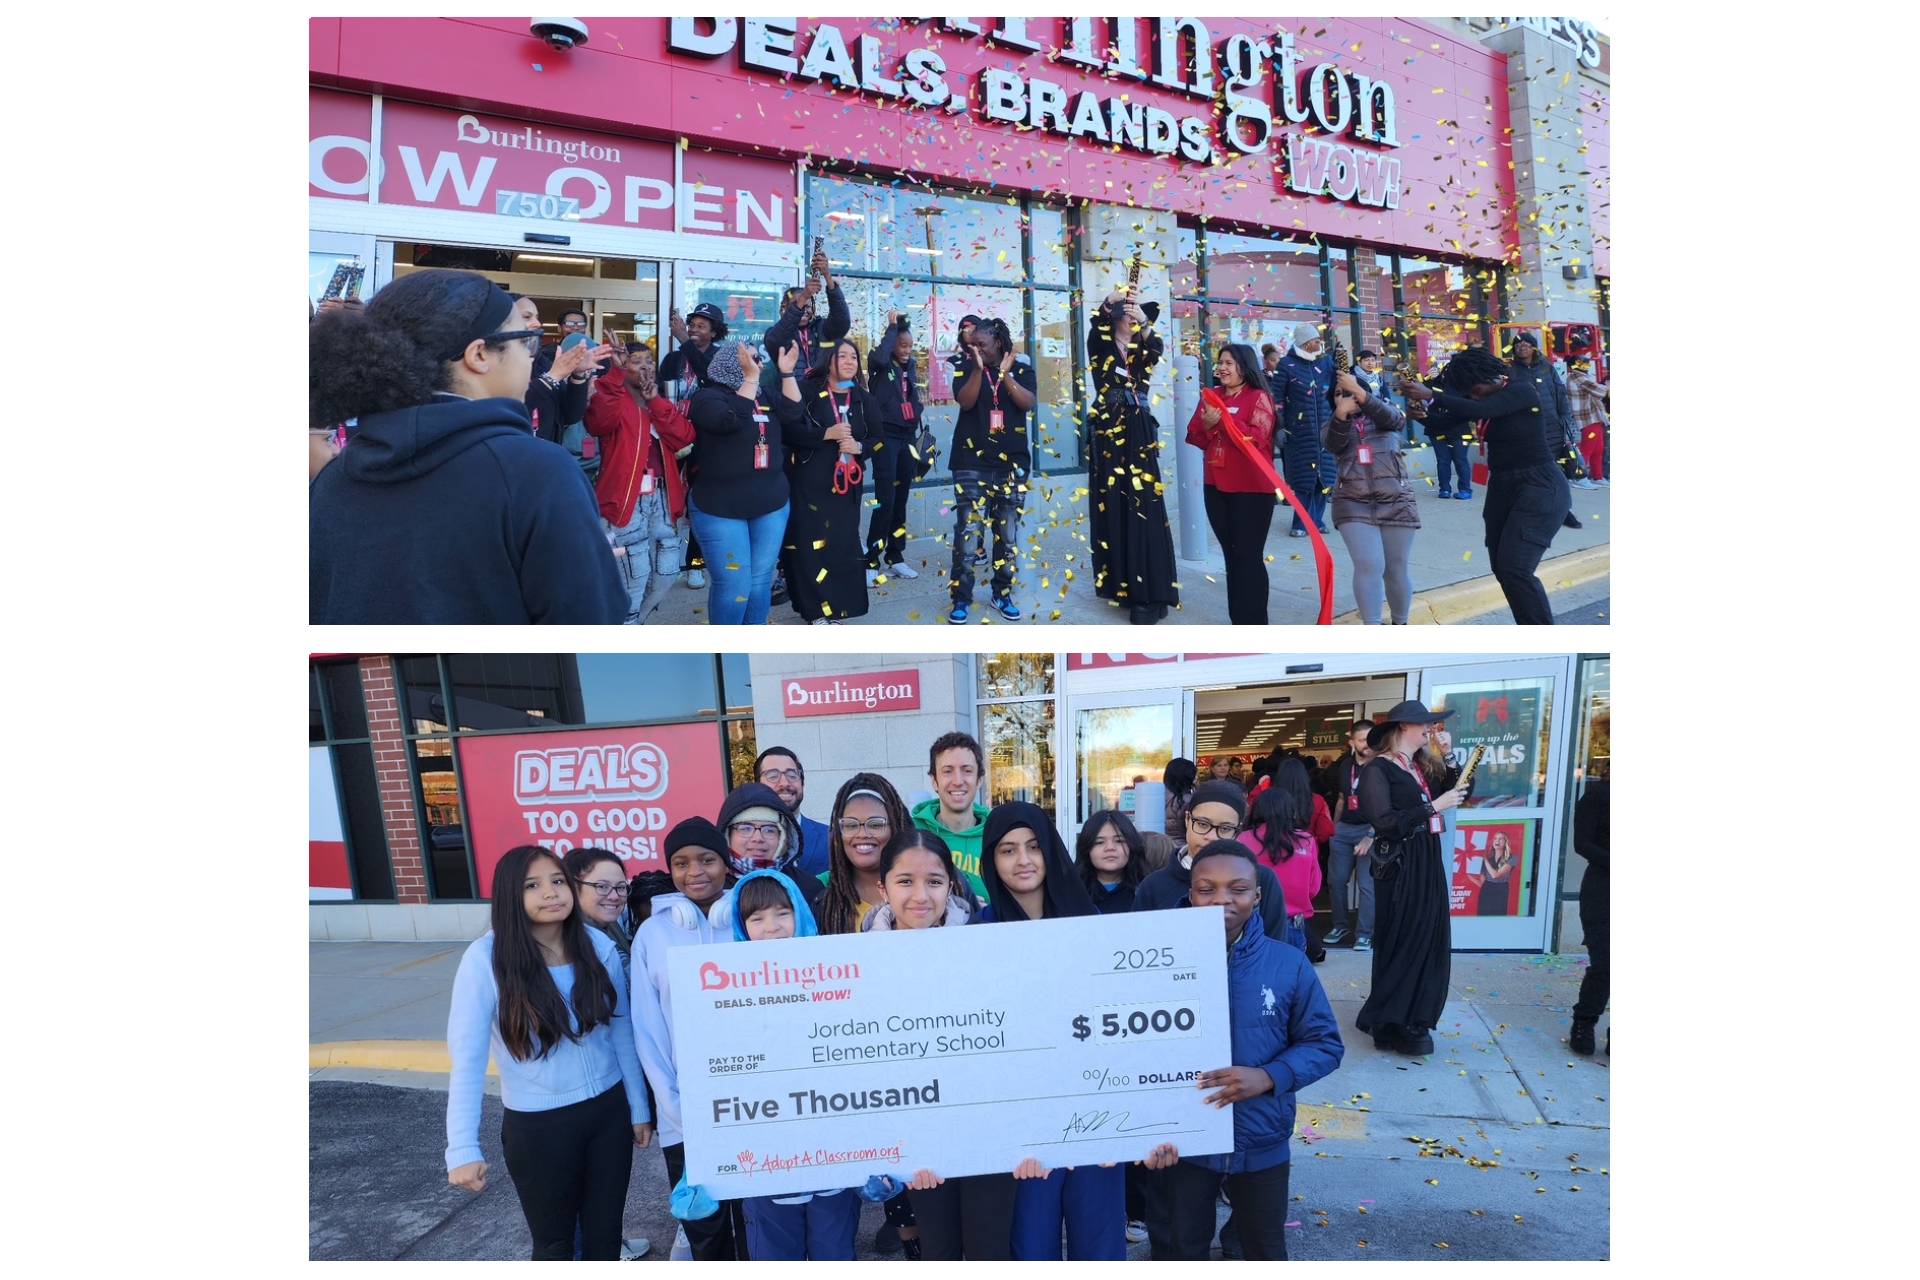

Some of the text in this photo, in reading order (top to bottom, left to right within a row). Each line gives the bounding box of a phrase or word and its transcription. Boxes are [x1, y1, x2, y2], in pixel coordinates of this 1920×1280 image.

[457, 115, 622, 163] Burlington
[1287, 133, 1400, 209] WOW!
[496, 190, 579, 219] 7507
[545, 167, 783, 238] OPEN
[787, 680, 913, 708] Burlington
[1312, 734, 1339, 744] STYLE
[1460, 732, 1519, 745] wrap up the
[1453, 744, 1526, 766] DALS
[517, 746, 663, 799] DEALS
[523, 807, 667, 835] TOO GOOD
[1113, 947, 1175, 970] 2025
[700, 961, 861, 990] Burlington
[1173, 973, 1197, 981] DATE
[715, 989, 851, 1009] DEALS. BRANDS. WOW!
[808, 1009, 1005, 1039] Jordan Community
[1102, 1008, 1195, 1038] 5,000
[709, 1057, 728, 1065] PAY
[747, 1054, 766, 1062] THE
[812, 1031, 1005, 1063] Elementary School
[709, 1062, 758, 1073] ORDER OF
[712, 1079, 940, 1123] Five Thousand
[718, 1164, 737, 1172] FOR
